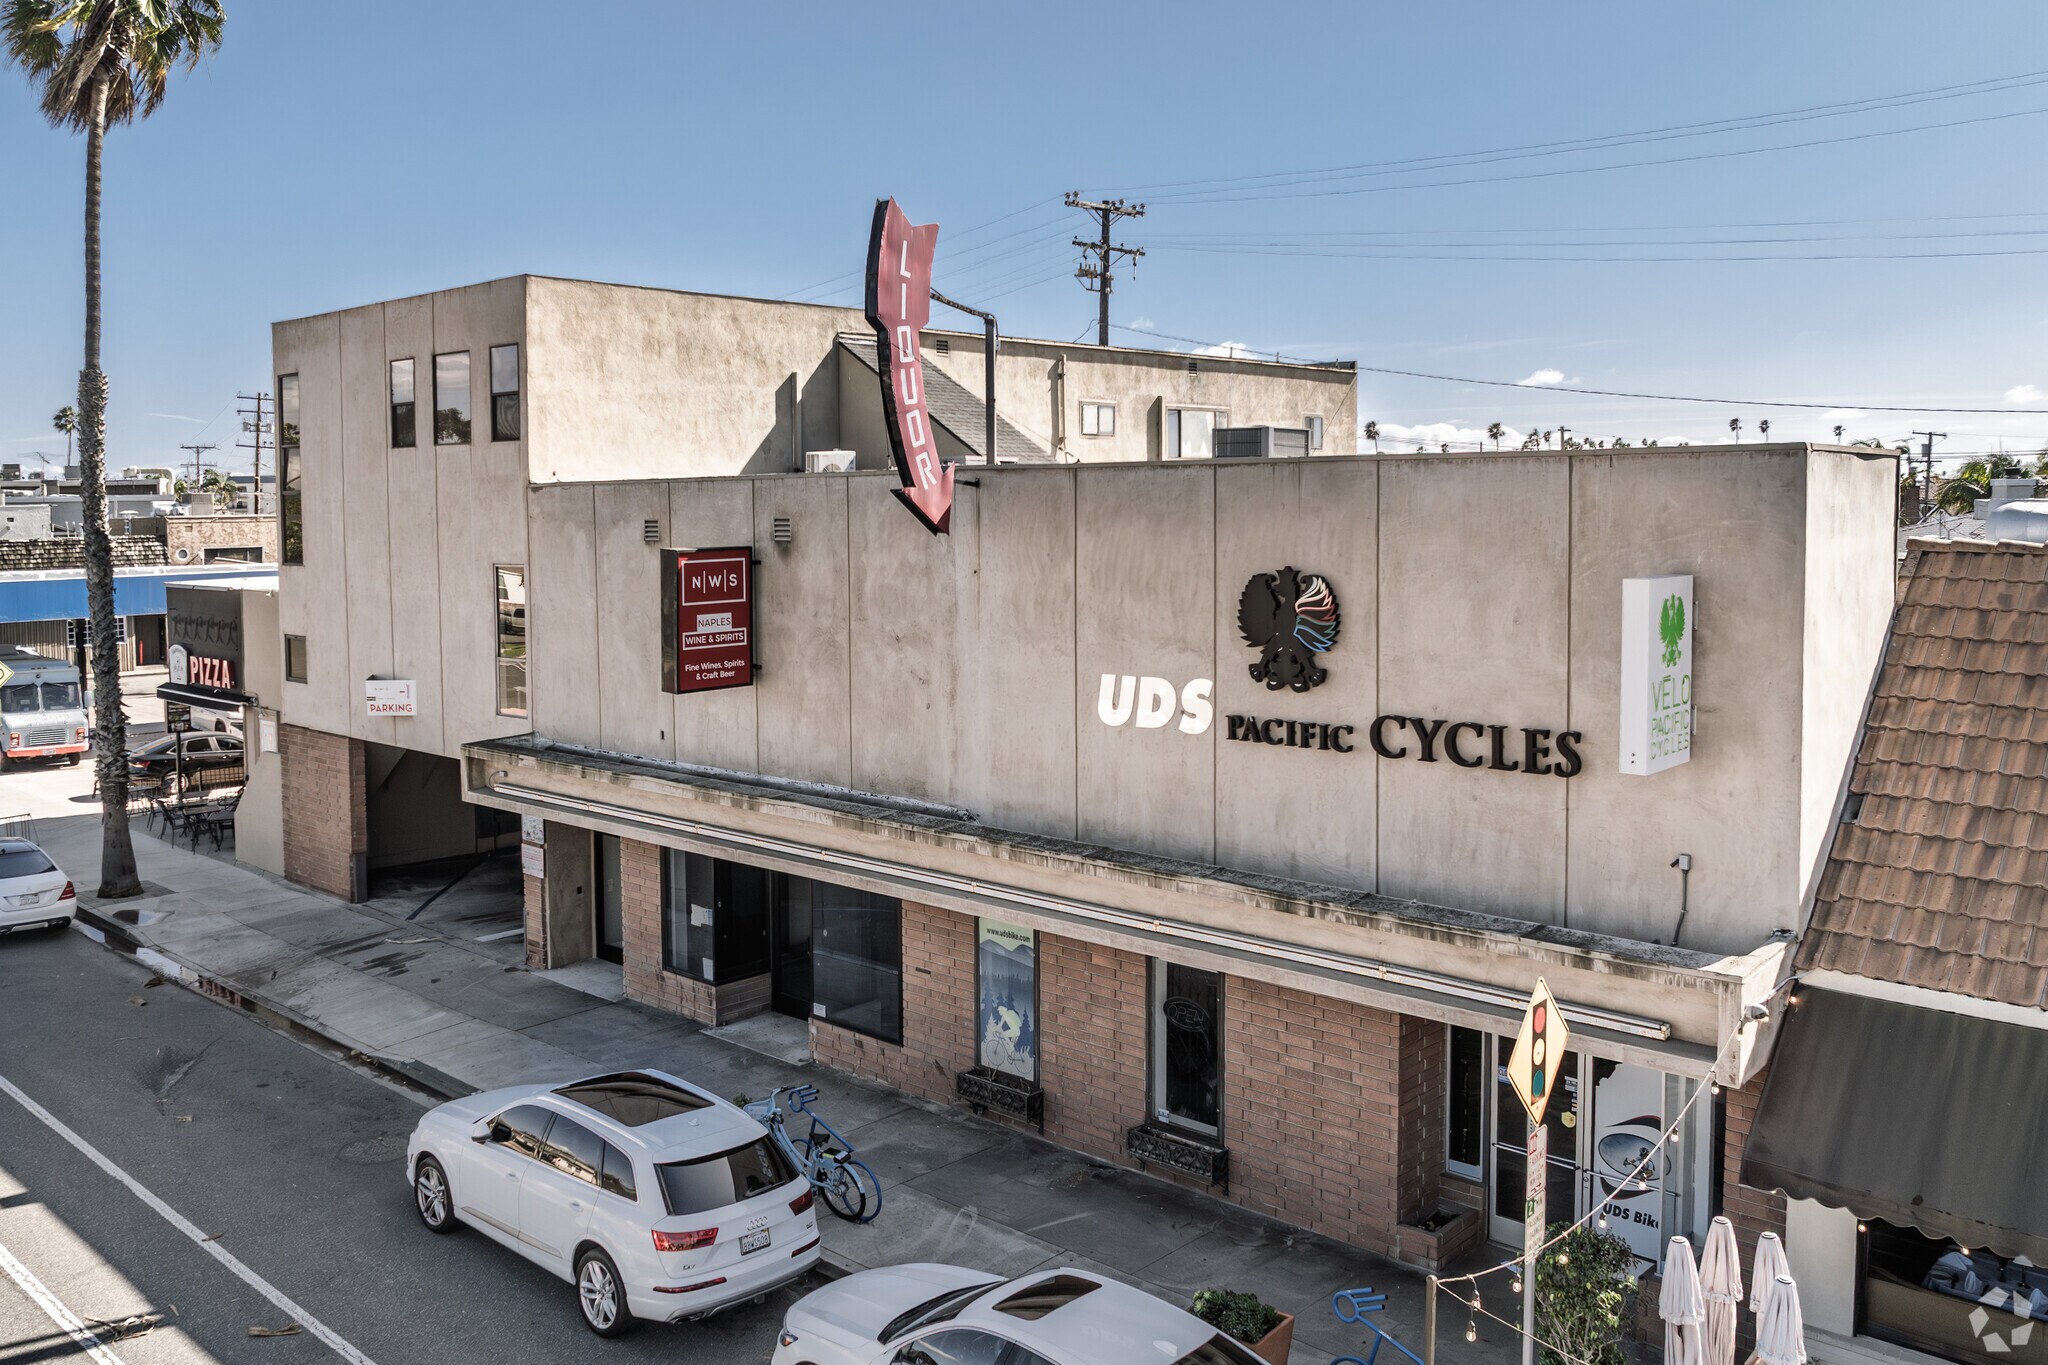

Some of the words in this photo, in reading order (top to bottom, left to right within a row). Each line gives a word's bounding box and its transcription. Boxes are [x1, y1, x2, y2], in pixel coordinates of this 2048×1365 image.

[897, 240, 937, 490] LIQUOR
[698, 617, 731, 628] NAPLES
[685, 635, 707, 645] WINE
[708, 635, 714, 643] &
[715, 632, 744, 642] SPIRITS
[190, 656, 231, 689] PIZZA
[685, 663, 700, 672] Fine
[724, 659, 745, 669] Spirits
[702, 670, 718, 680] Craft
[720, 670, 735, 678] Beer
[370, 703, 413, 713] PARKING
[1098, 673, 1214, 735] UDS
[1651, 709, 1690, 737] PACIFIC
[1225, 714, 1354, 753] PACIFIC
[1370, 714, 1582, 778] CYCLES
[1650, 731, 1689, 760] CYCLES
[986, 927, 1031, 943] www.udsbike.com
[1167, 1004, 1204, 1024] OPEN
[1603, 1202, 1630, 1220] UDS
